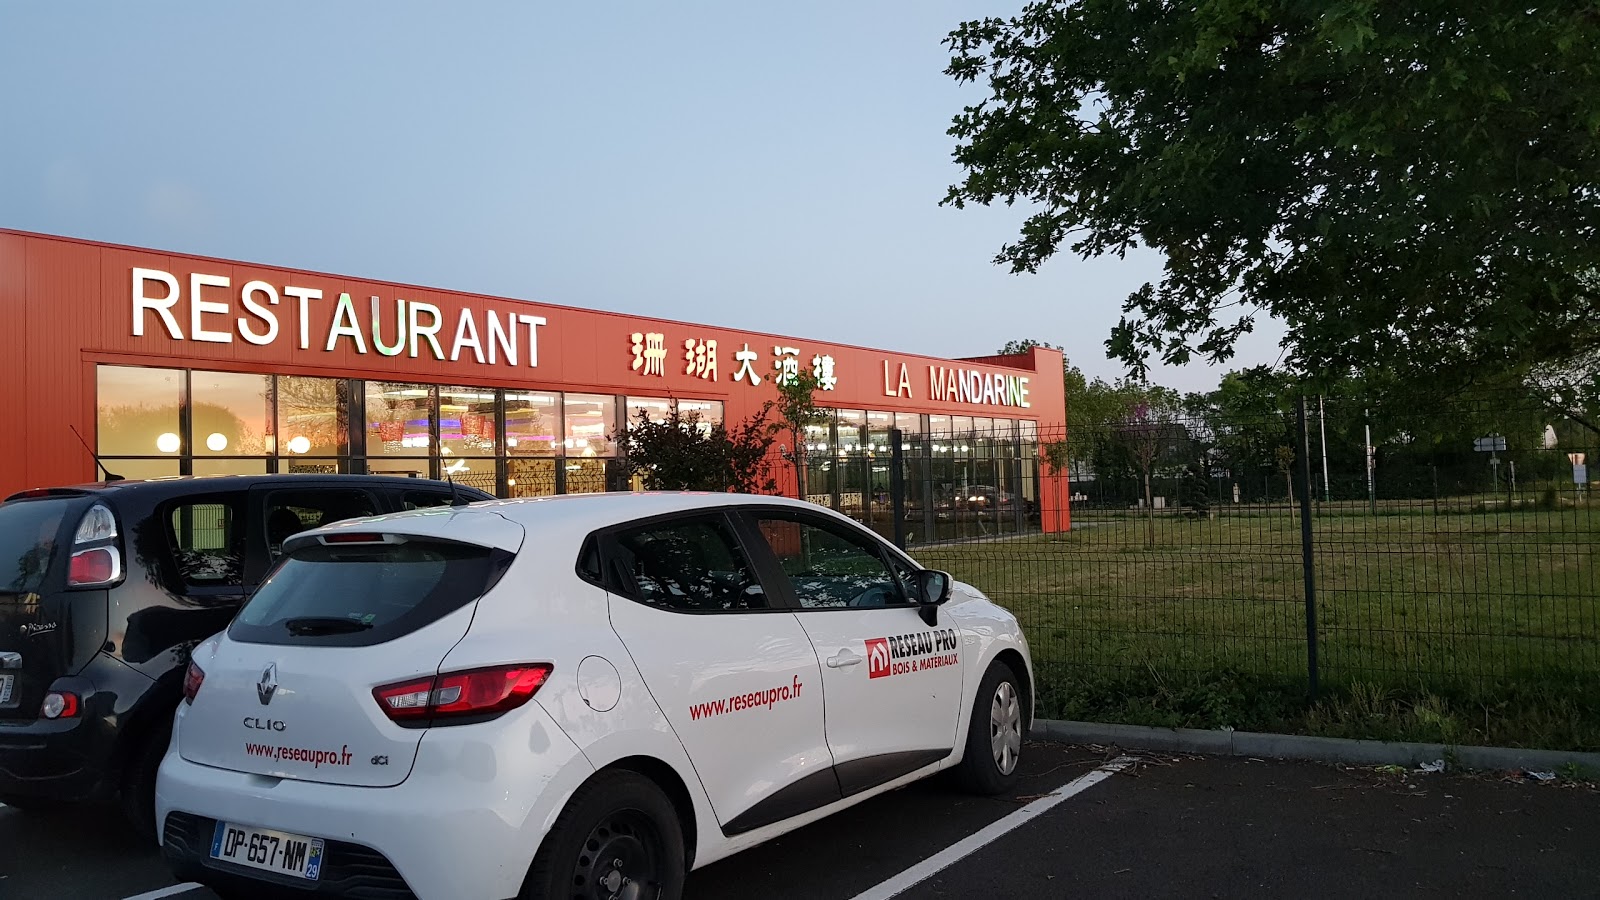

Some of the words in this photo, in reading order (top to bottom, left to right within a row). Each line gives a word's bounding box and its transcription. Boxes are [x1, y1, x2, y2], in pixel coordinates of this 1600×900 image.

[131, 267, 547, 367] RESTAURANT
[884, 360, 912, 398] LA
[930, 366, 1030, 408] MANDARINE
[888, 632, 932, 659] RESEAU
[933, 629, 957, 651] PRO
[893, 661, 910, 675] BOIS
[912, 660, 918, 672] &
[920, 653, 958, 670] MATÉRIAUX
[690, 675, 802, 720] www.reseaupro.fr
[243, 717, 287, 732] CLIO
[246, 743, 352, 768] www.reseaupro.fr
[224, 828, 307, 872] DP-657-NM
[306, 864, 317, 878] 29
